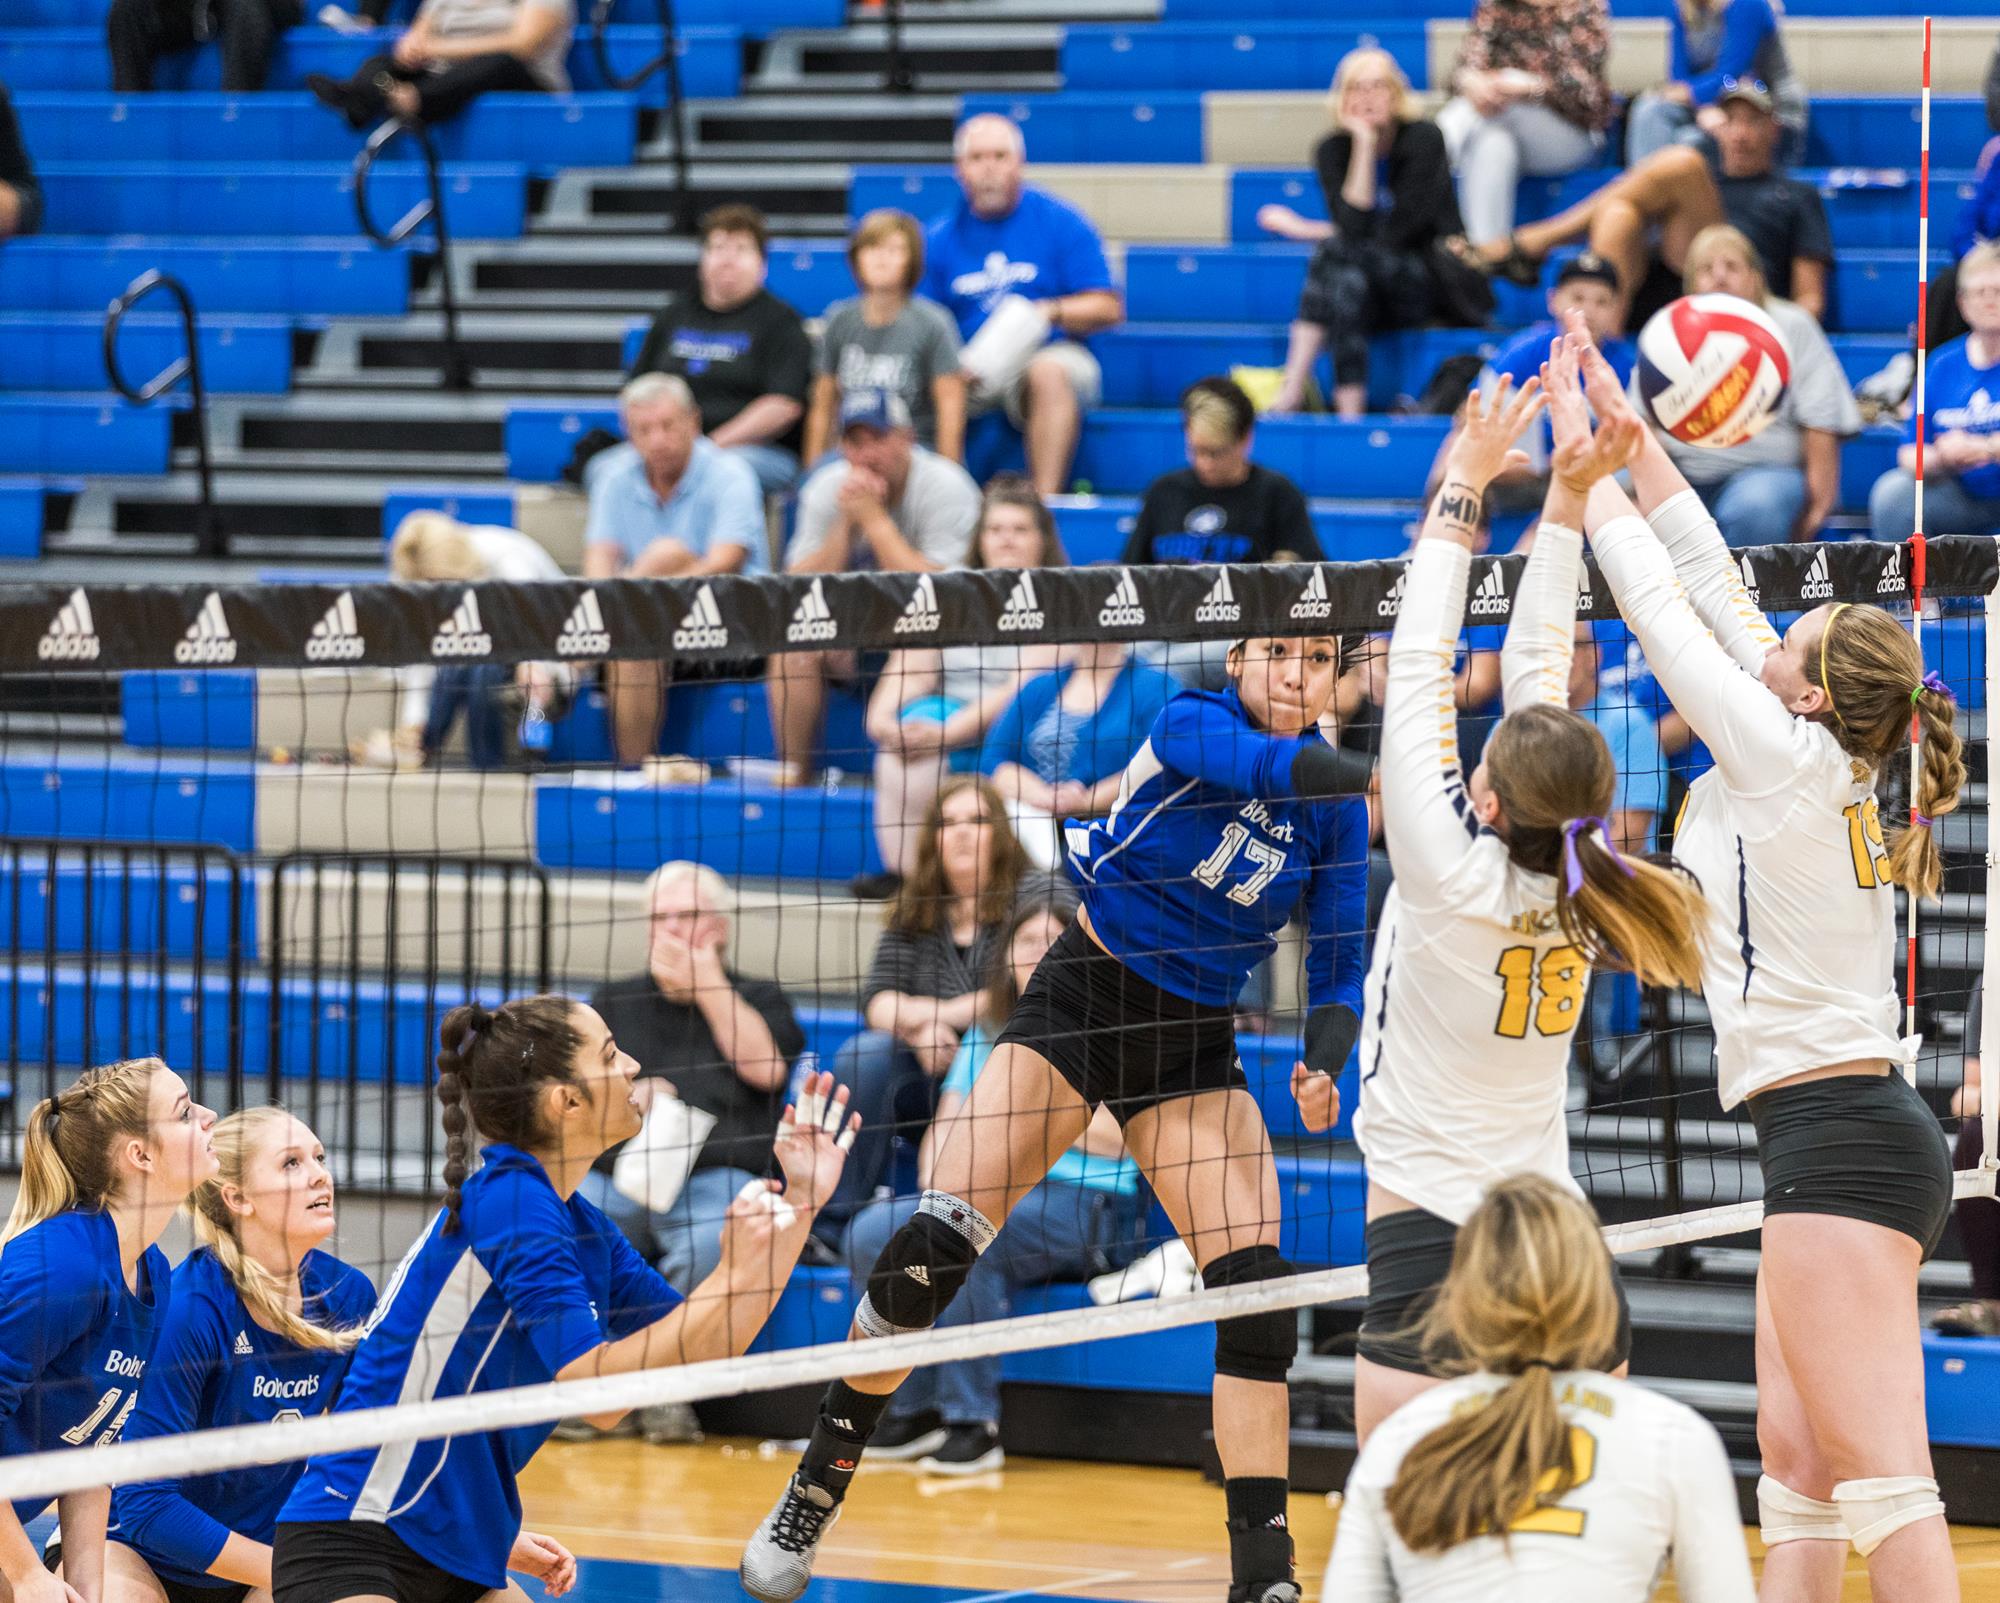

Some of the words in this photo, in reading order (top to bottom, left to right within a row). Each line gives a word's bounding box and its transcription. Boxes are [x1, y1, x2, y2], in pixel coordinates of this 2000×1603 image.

[1801, 580, 1834, 600] adidas
[1877, 575, 1906, 595] adidas
[1099, 605, 1146, 627] adidas
[1195, 601, 1240, 622] adidas
[1290, 599, 1332, 619] adidas
[1470, 595, 1510, 615] adidas
[787, 619, 837, 643] adidas
[893, 611, 940, 634] adidas
[997, 609, 1045, 631] adidas
[431, 633, 492, 656] adidas
[556, 631, 611, 655] adidas
[672, 627, 728, 650] adidas
[1191, 821, 1287, 907] 17
[1494, 945, 1586, 1039] 18
[104, 1350, 146, 1379] Bobc
[253, 1374, 320, 1398] Bobcats
